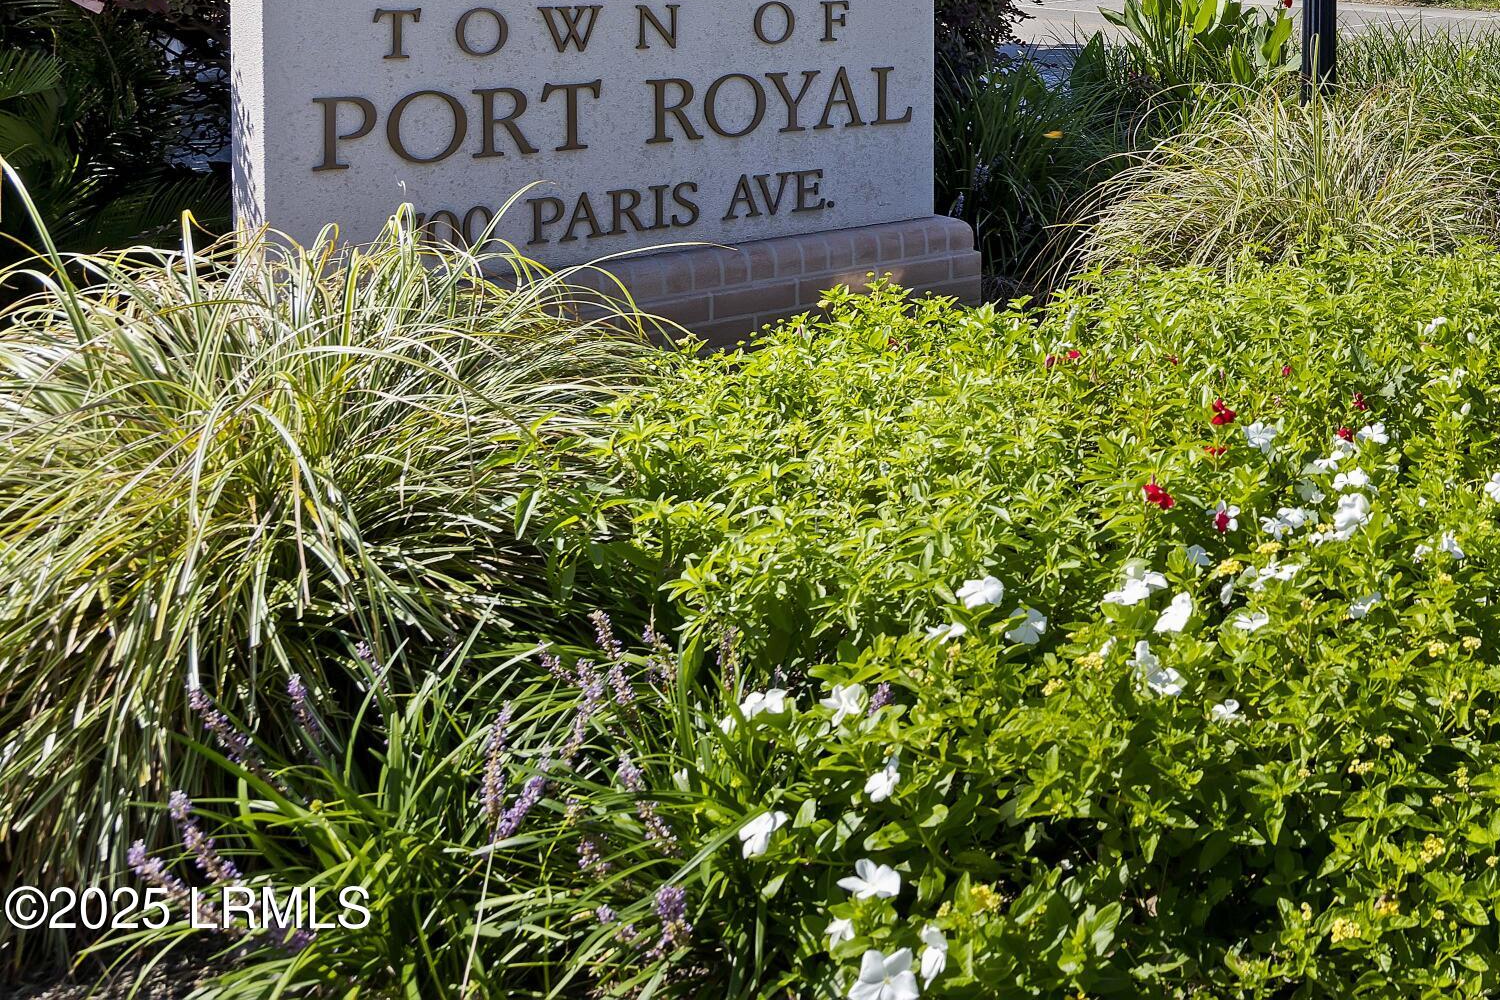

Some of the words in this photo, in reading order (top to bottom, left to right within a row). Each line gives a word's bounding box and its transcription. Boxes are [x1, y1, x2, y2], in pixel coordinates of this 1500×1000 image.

[372, 4, 680, 60] TOWN
[753, 0, 850, 46] OF
[312, 78, 602, 172] PORT
[646, 66, 913, 145] ROYAL
[526, 180, 701, 246] PARIS
[722, 168, 836, 221] AVE.
